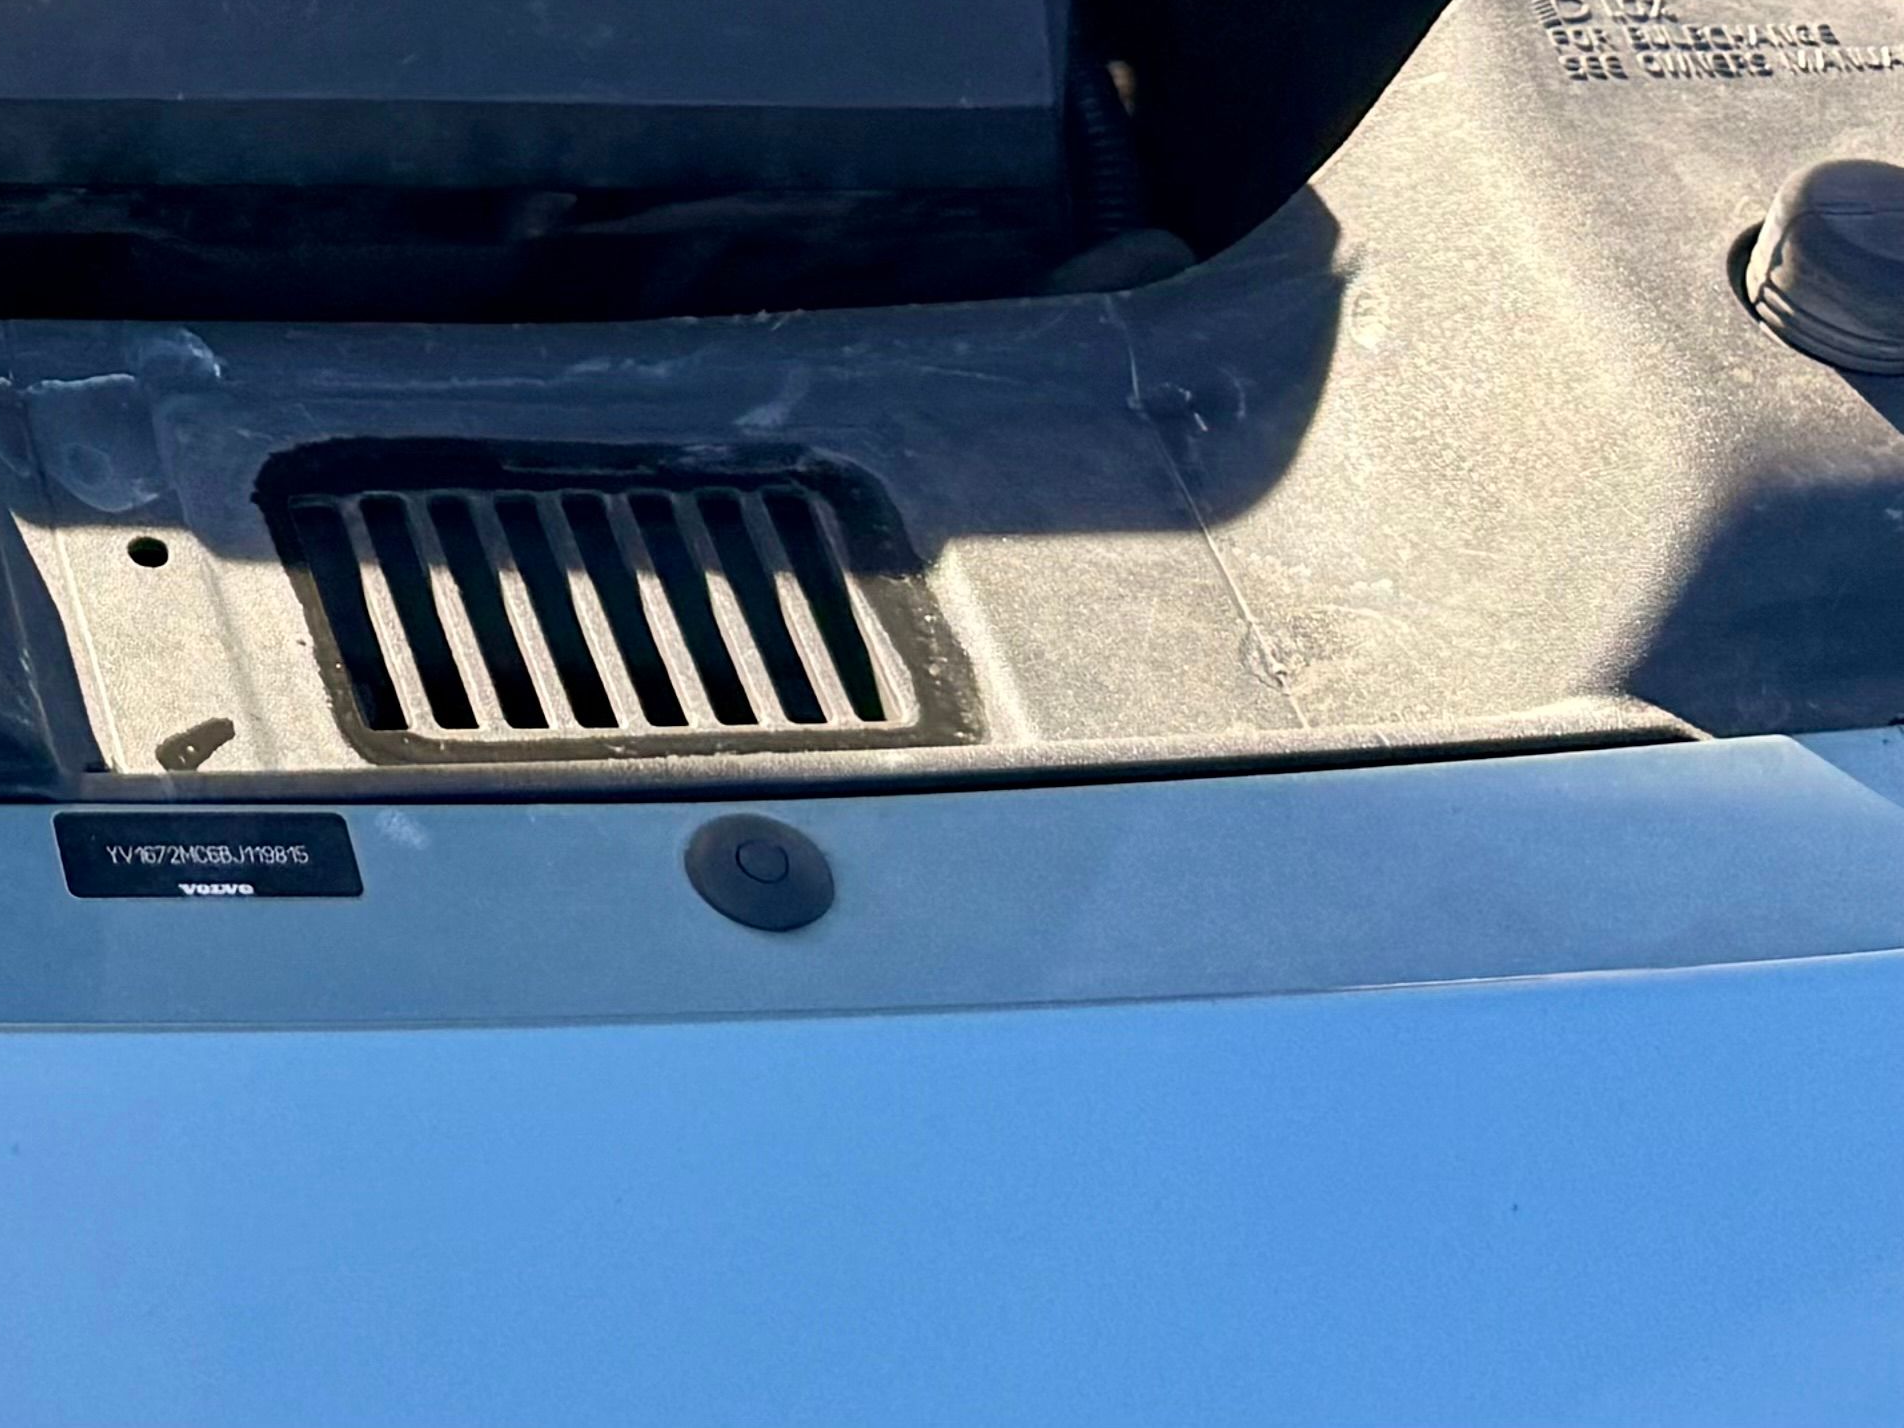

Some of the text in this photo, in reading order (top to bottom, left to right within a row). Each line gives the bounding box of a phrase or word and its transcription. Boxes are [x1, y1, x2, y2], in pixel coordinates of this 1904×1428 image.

[1546, 25, 1618, 53] FOR
[1558, 52, 1629, 82] SEE
[1637, 50, 1774, 81] OWNERS
[178, 883, 255, 895] VOLVO
